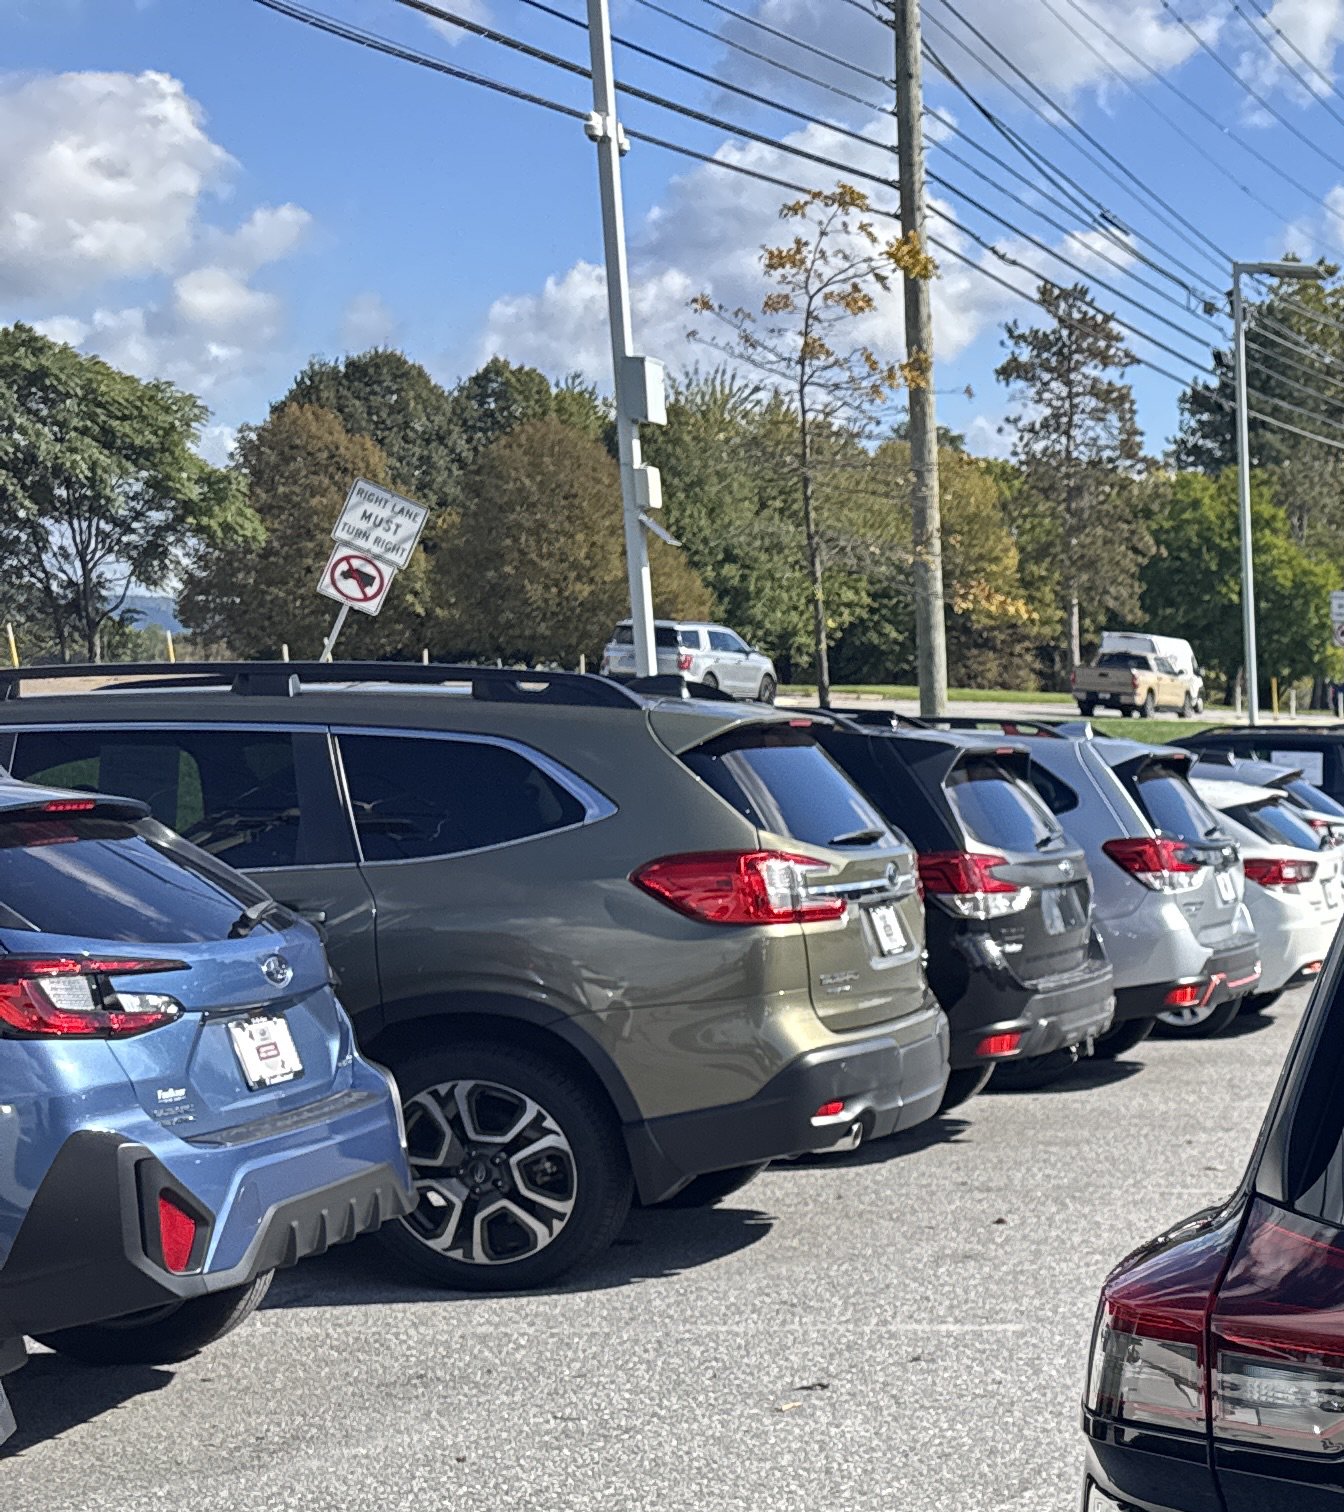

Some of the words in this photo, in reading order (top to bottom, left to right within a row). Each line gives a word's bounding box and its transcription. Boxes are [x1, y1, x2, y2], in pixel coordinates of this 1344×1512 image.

[355, 487, 390, 510] RIGHT
[390, 502, 420, 524] LANE
[360, 508, 403, 536] MUST
[340, 521, 371, 543] TURN
[372, 535, 407, 558] RIGHT
